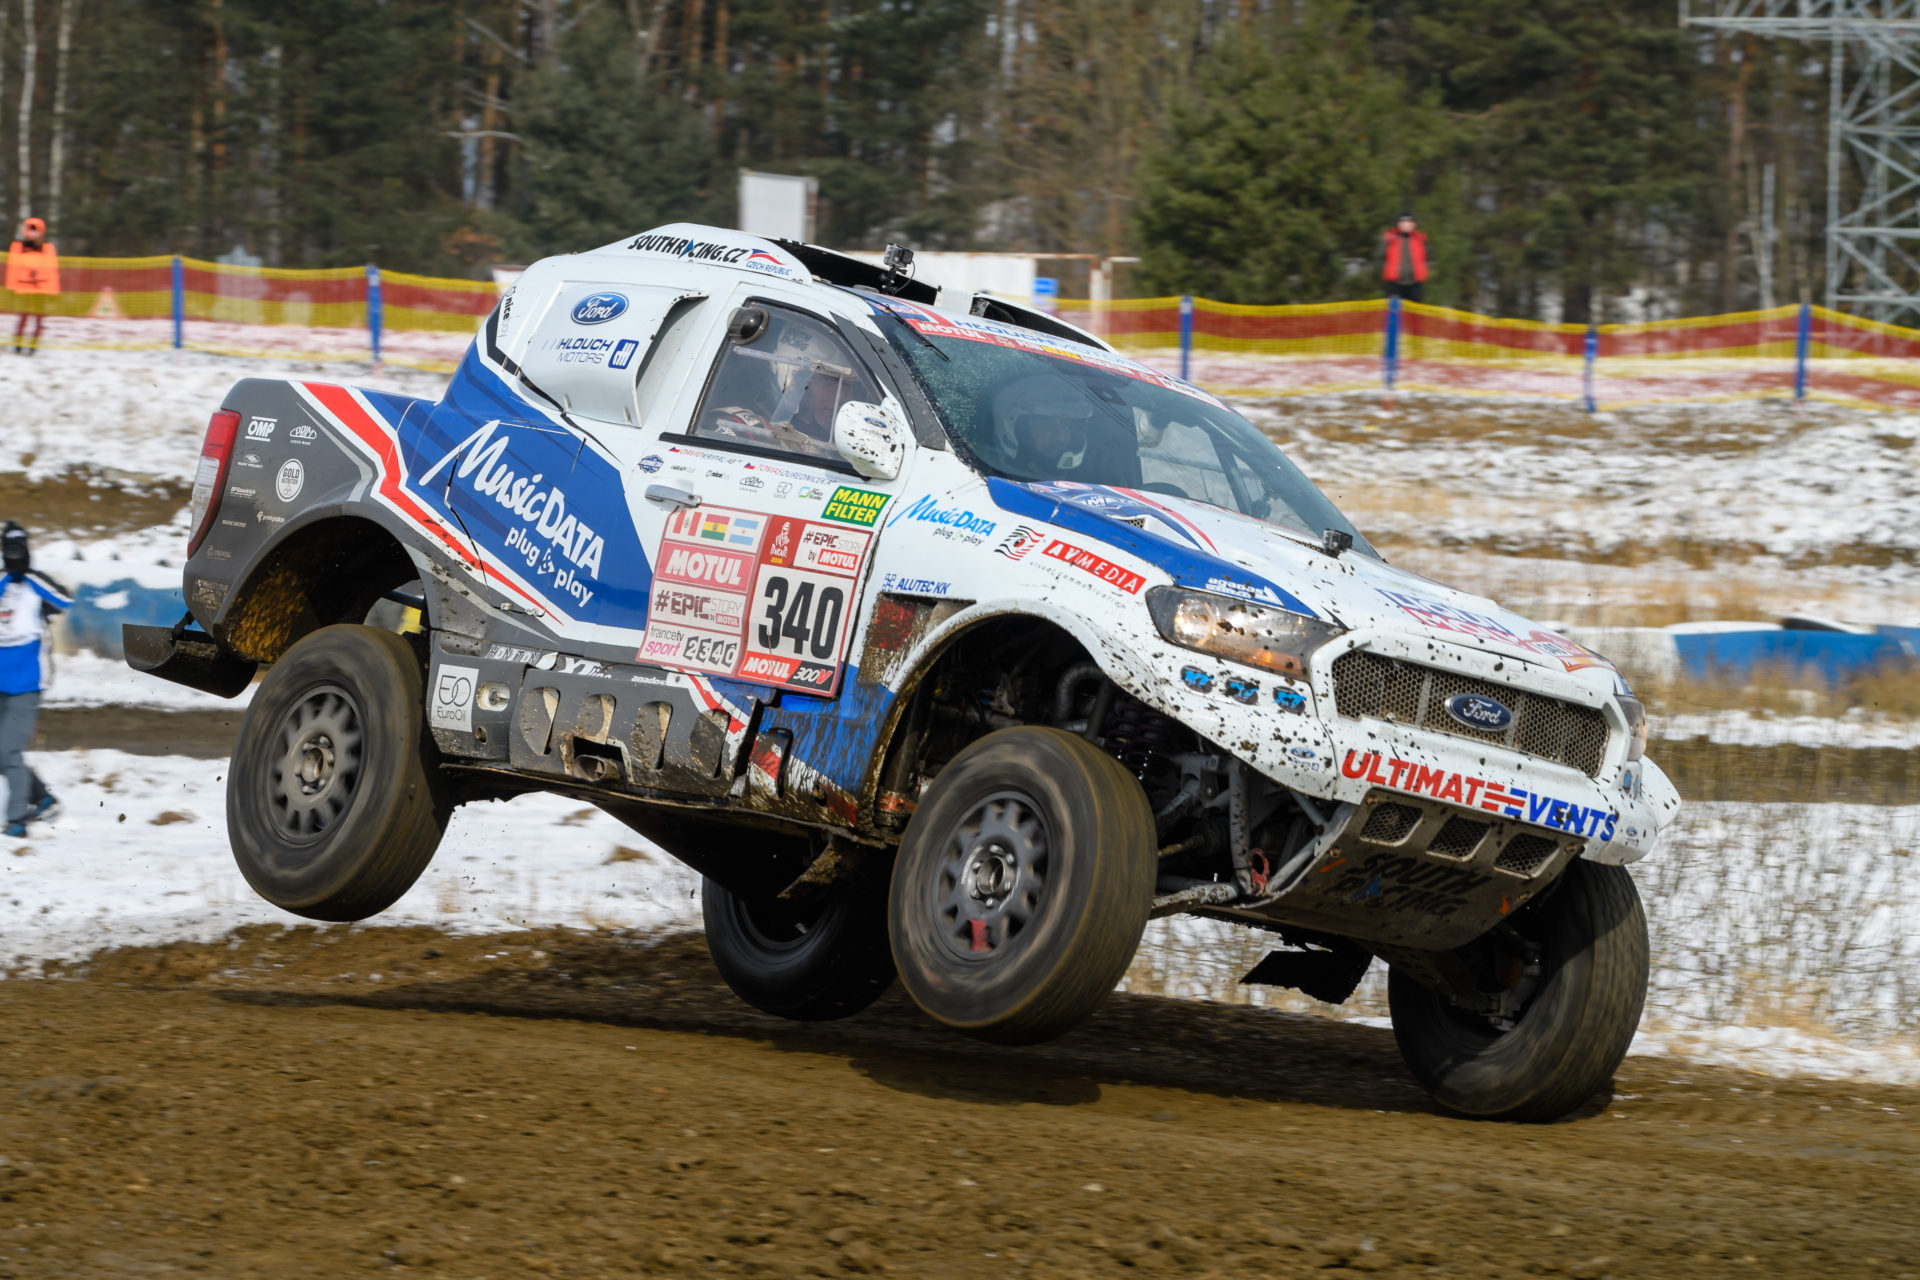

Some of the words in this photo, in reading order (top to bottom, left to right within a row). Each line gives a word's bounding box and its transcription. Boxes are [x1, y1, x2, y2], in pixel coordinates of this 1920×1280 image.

[745, 260, 765, 271] CZECH
[764, 264, 793, 277] REPUBLIC
[578, 295, 615, 319] Ford
[917, 321, 988, 341] MOTUL
[557, 337, 614, 352] HLOUCH
[556, 351, 605, 364] MOTORS
[247, 420, 275, 438] OMP
[282, 467, 300, 479] GOLD
[418, 419, 605, 581] MusicDATA
[832, 488, 888, 509] MANN
[824, 502, 878, 525] FILTER
[886, 493, 997, 537] MusicDATA
[932, 525, 954, 540] plug
[961, 534, 985, 548] play
[504, 526, 541, 569] plug
[553, 568, 594, 608] play
[665, 549, 742, 586] MOTUL
[807, 549, 816, 562] by
[819, 548, 856, 568] MOTUL
[895, 577, 935, 593] ALUTEC
[932, 582, 952, 595] KK
[716, 614, 739, 627] MOTUL
[758, 575, 845, 660] 340
[644, 640, 681, 657] sport
[743, 656, 792, 679] MOTUL
[793, 664, 833, 685] 300V
[1461, 697, 1502, 725] Ford
[1341, 748, 1526, 813] ULTIMATE
[1504, 787, 1620, 843] EVENTS
